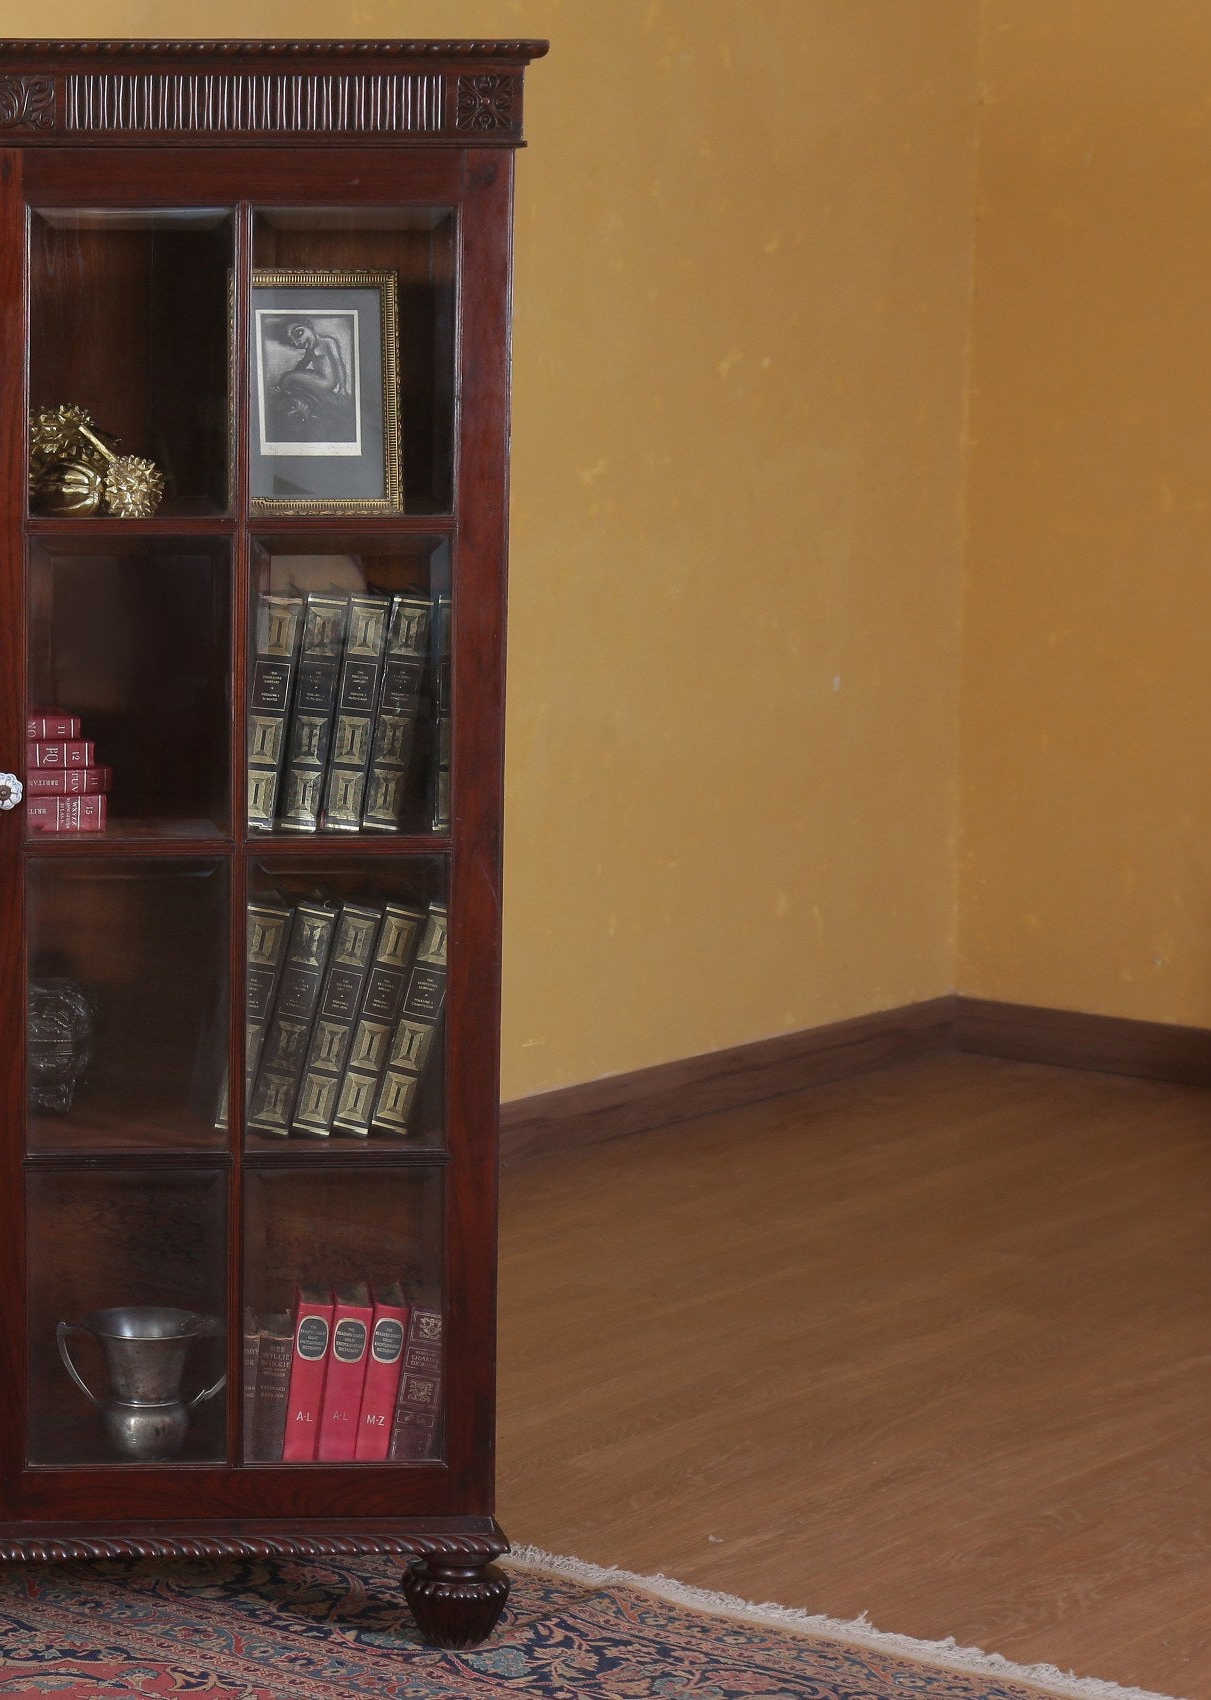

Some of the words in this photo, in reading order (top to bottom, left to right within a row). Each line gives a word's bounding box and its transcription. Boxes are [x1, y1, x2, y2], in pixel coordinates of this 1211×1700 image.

[71, 751, 81, 761] 12
[85, 806, 94, 815] 15
[295, 1411, 313, 1422] A-L
[332, 1410, 348, 1421] A-L
[366, 1414, 385, 1426] M-Z
